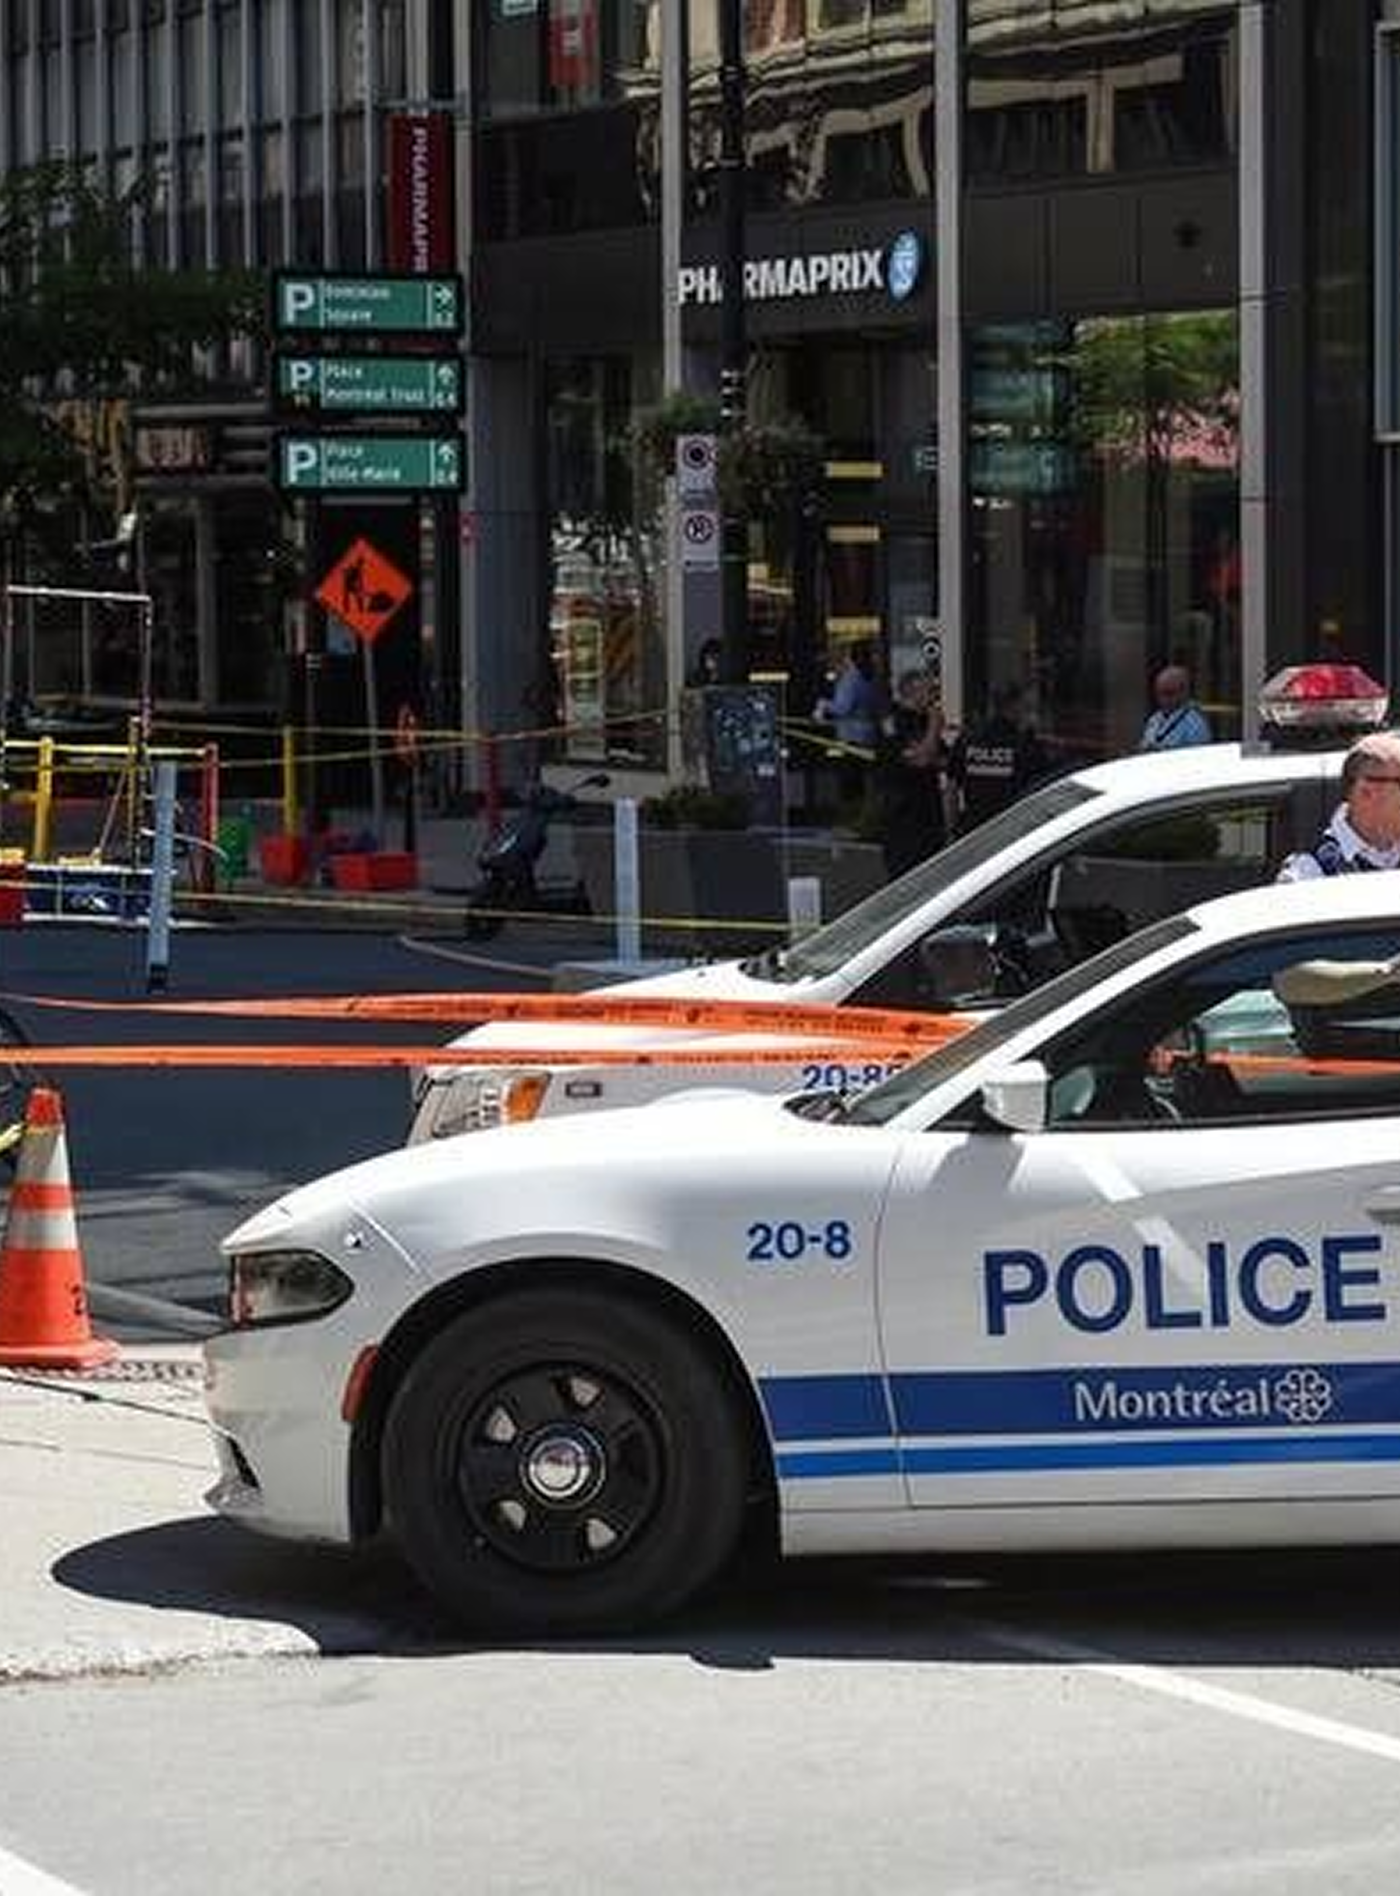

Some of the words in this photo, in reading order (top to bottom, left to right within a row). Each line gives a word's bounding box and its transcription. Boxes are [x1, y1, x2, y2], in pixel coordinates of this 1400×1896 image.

[678, 249, 884, 304] PHRMAPRIX
[285, 284, 315, 323] P
[290, 362, 313, 390] P
[288, 442, 318, 484] P
[966, 746, 1013, 763] POLICE
[746, 1220, 853, 1262] 20-8
[983, 1234, 1387, 1337] POLICE
[1074, 1380, 1272, 1423] Montréal
